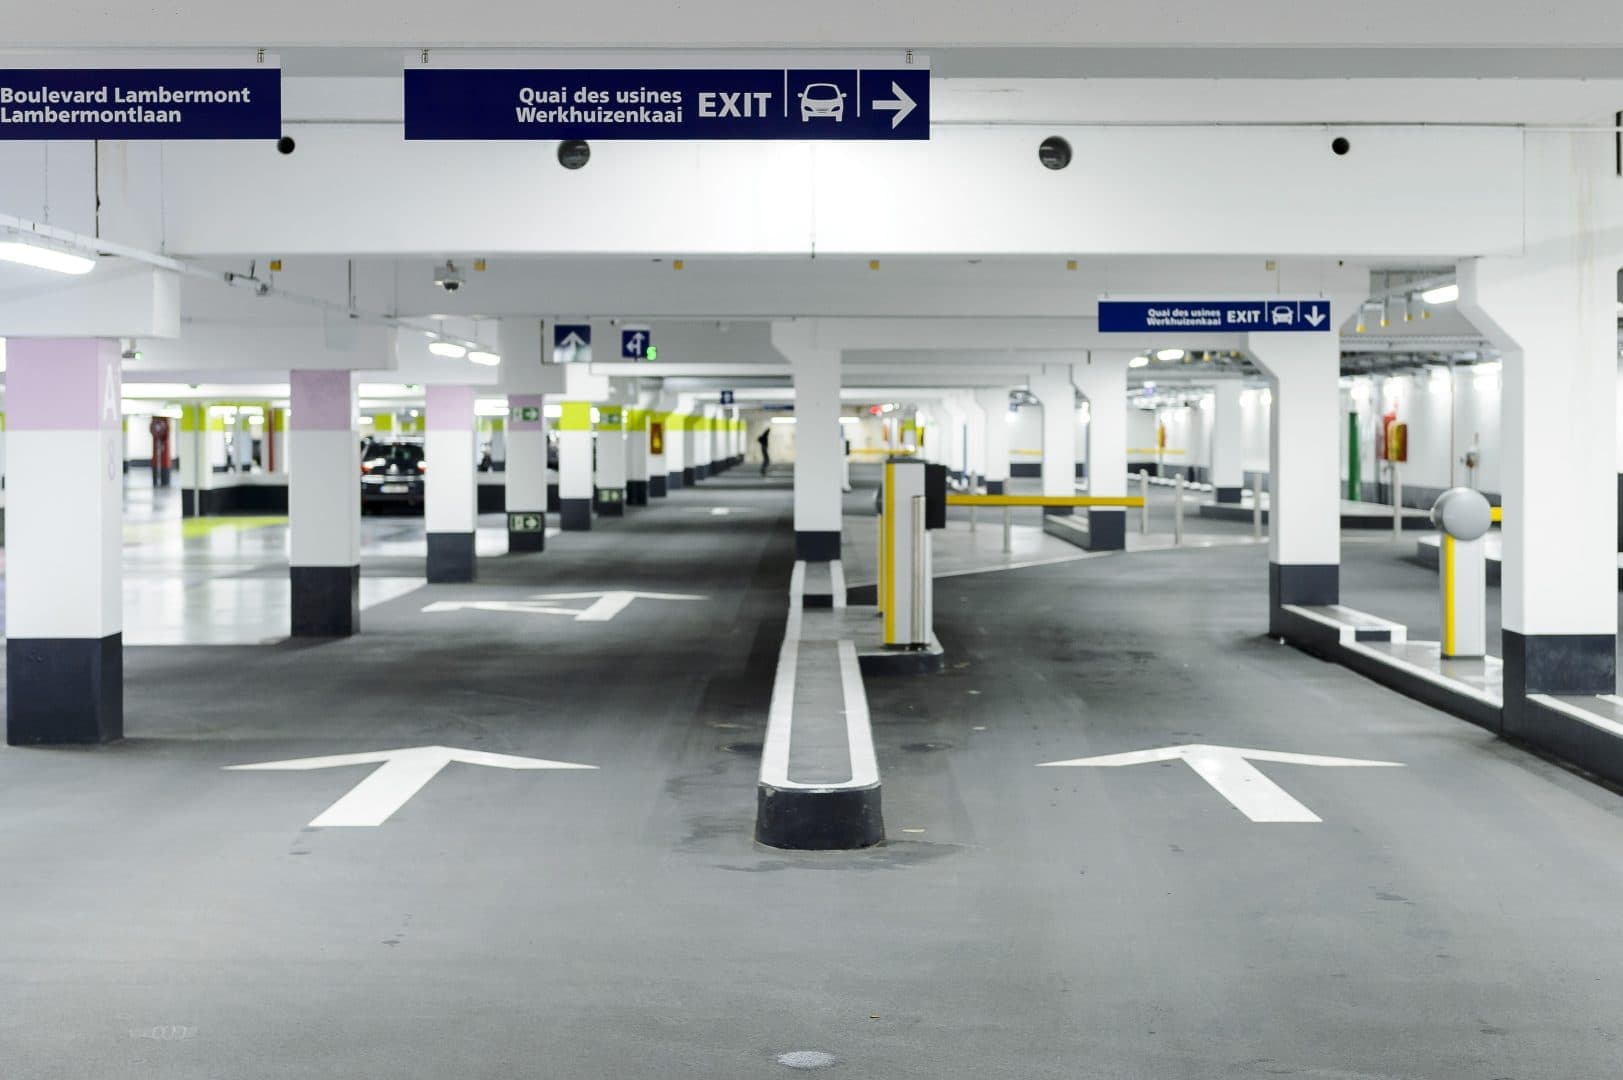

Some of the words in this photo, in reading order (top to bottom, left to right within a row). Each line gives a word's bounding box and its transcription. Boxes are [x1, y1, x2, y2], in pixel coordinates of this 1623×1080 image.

[0, 87, 107, 103] Boulevard
[115, 87, 251, 103] Lambermont
[519, 87, 567, 106] Quai
[574, 87, 610, 103] des
[616, 87, 682, 103] usines
[698, 92, 772, 118] EXIT
[0, 106, 182, 123] Lambermontlaan
[515, 106, 683, 123] Werkhuizenkaai
[1146, 316, 1222, 326] Werkhuizenkaai
[1147, 308, 1171, 318] Quai
[1171, 308, 1189, 317] des
[1190, 308, 1222, 317] usines
[1226, 310, 1261, 324] EXIT
